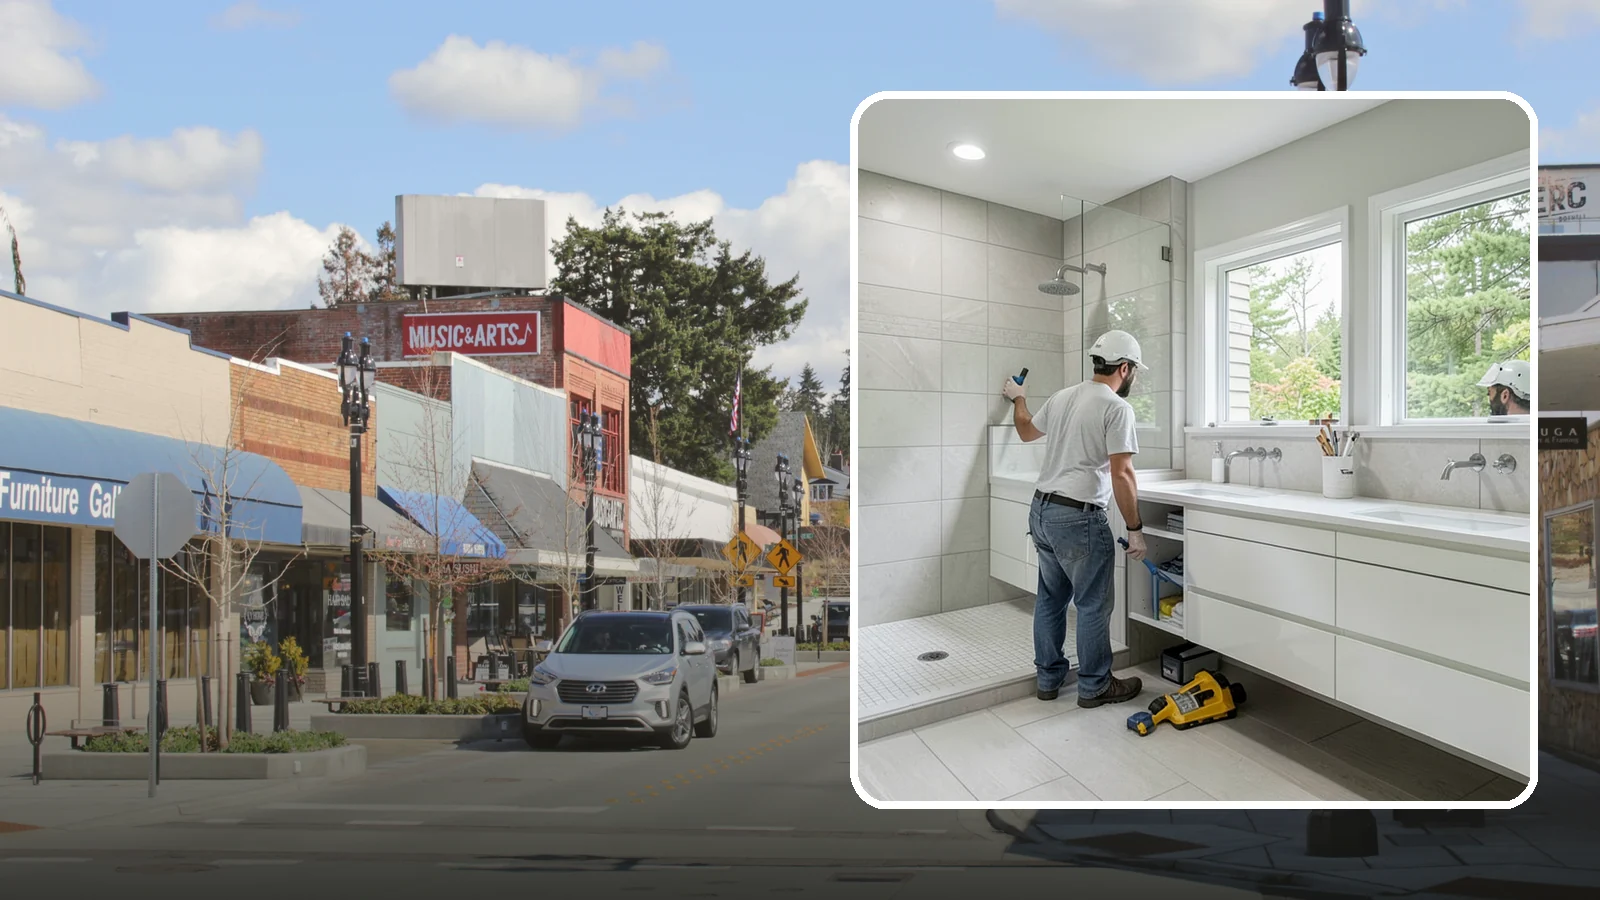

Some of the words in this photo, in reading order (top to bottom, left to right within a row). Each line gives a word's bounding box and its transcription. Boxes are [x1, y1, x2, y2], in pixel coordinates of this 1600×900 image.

[409, 323, 520, 348] MUSIC&ARTS
[1540, 427, 1578, 437] UGA
[0, 472, 79, 515] Furniture
[90, 482, 122, 519] Gal
